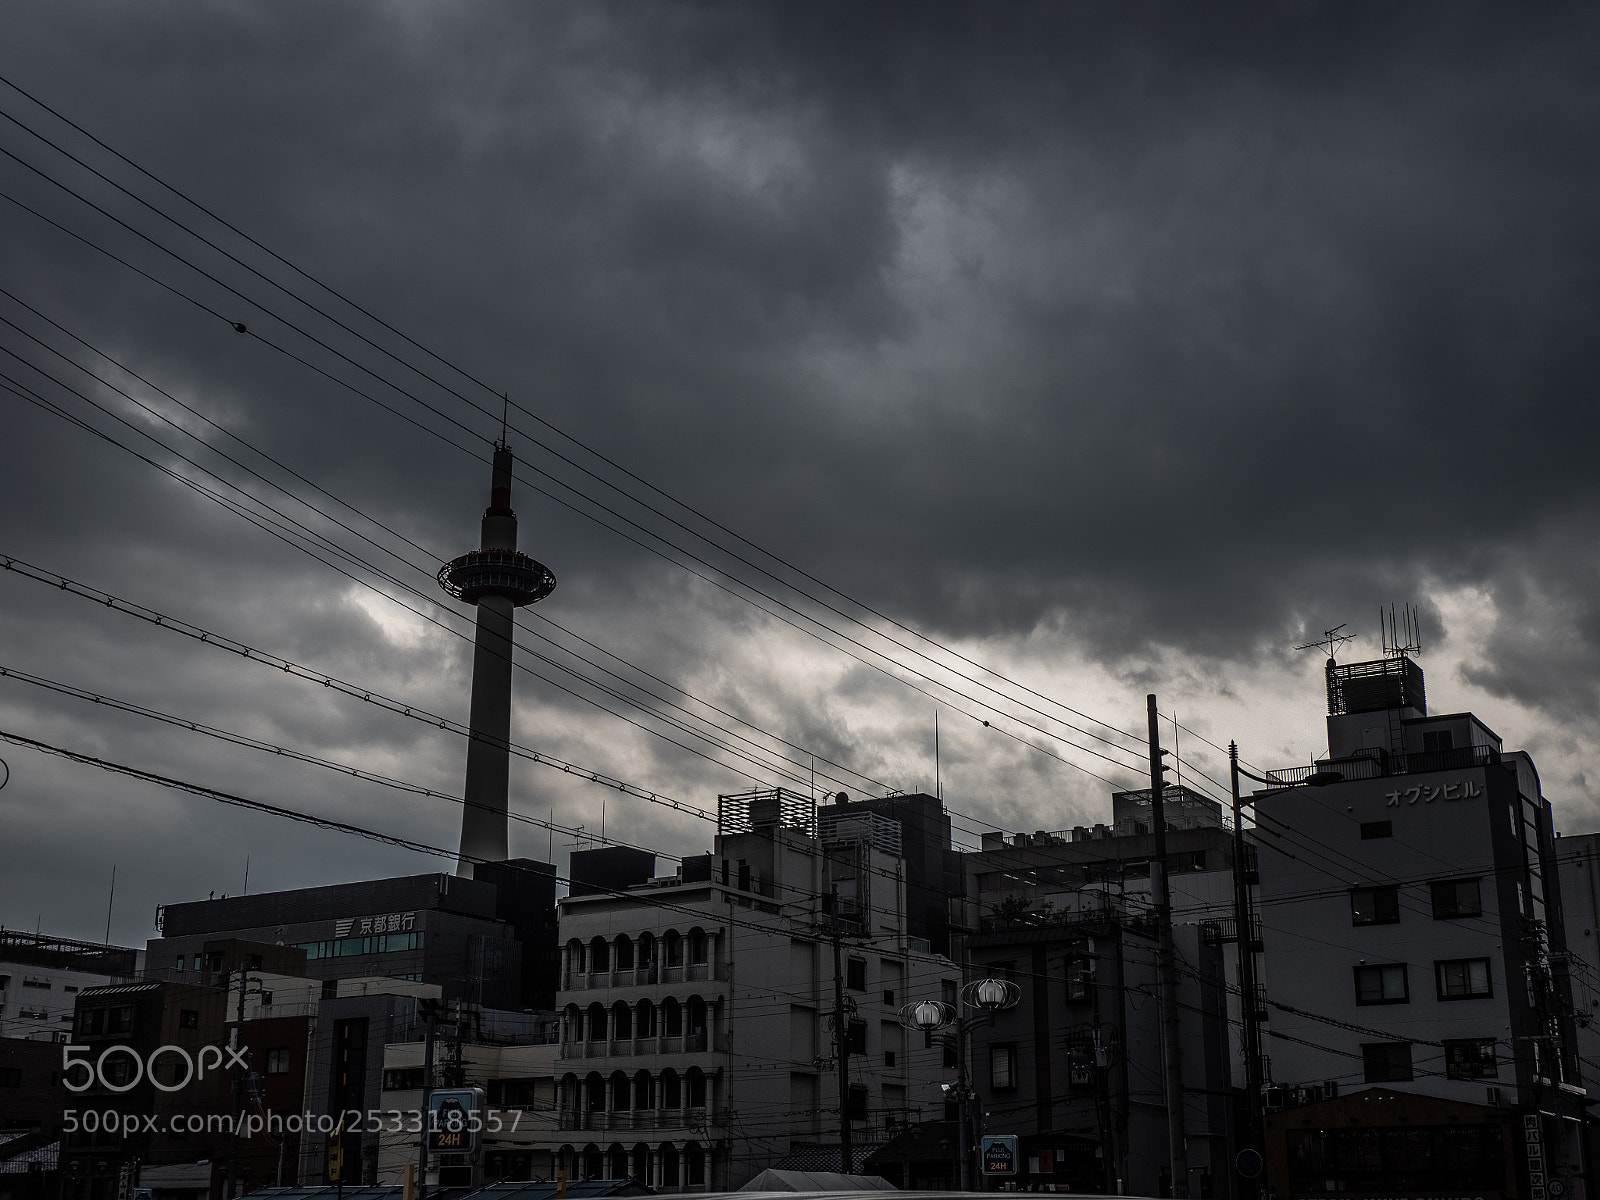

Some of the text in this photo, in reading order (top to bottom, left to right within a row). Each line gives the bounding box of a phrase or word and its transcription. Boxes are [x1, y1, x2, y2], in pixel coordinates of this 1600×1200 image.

[1385, 780, 1481, 807] オグシビル
[359, 912, 416, 935] 京都銀行
[438, 1133, 460, 1146] 24H
[990, 1162, 1007, 1170] 24H
[1551, 1183, 1562, 1193] 40
